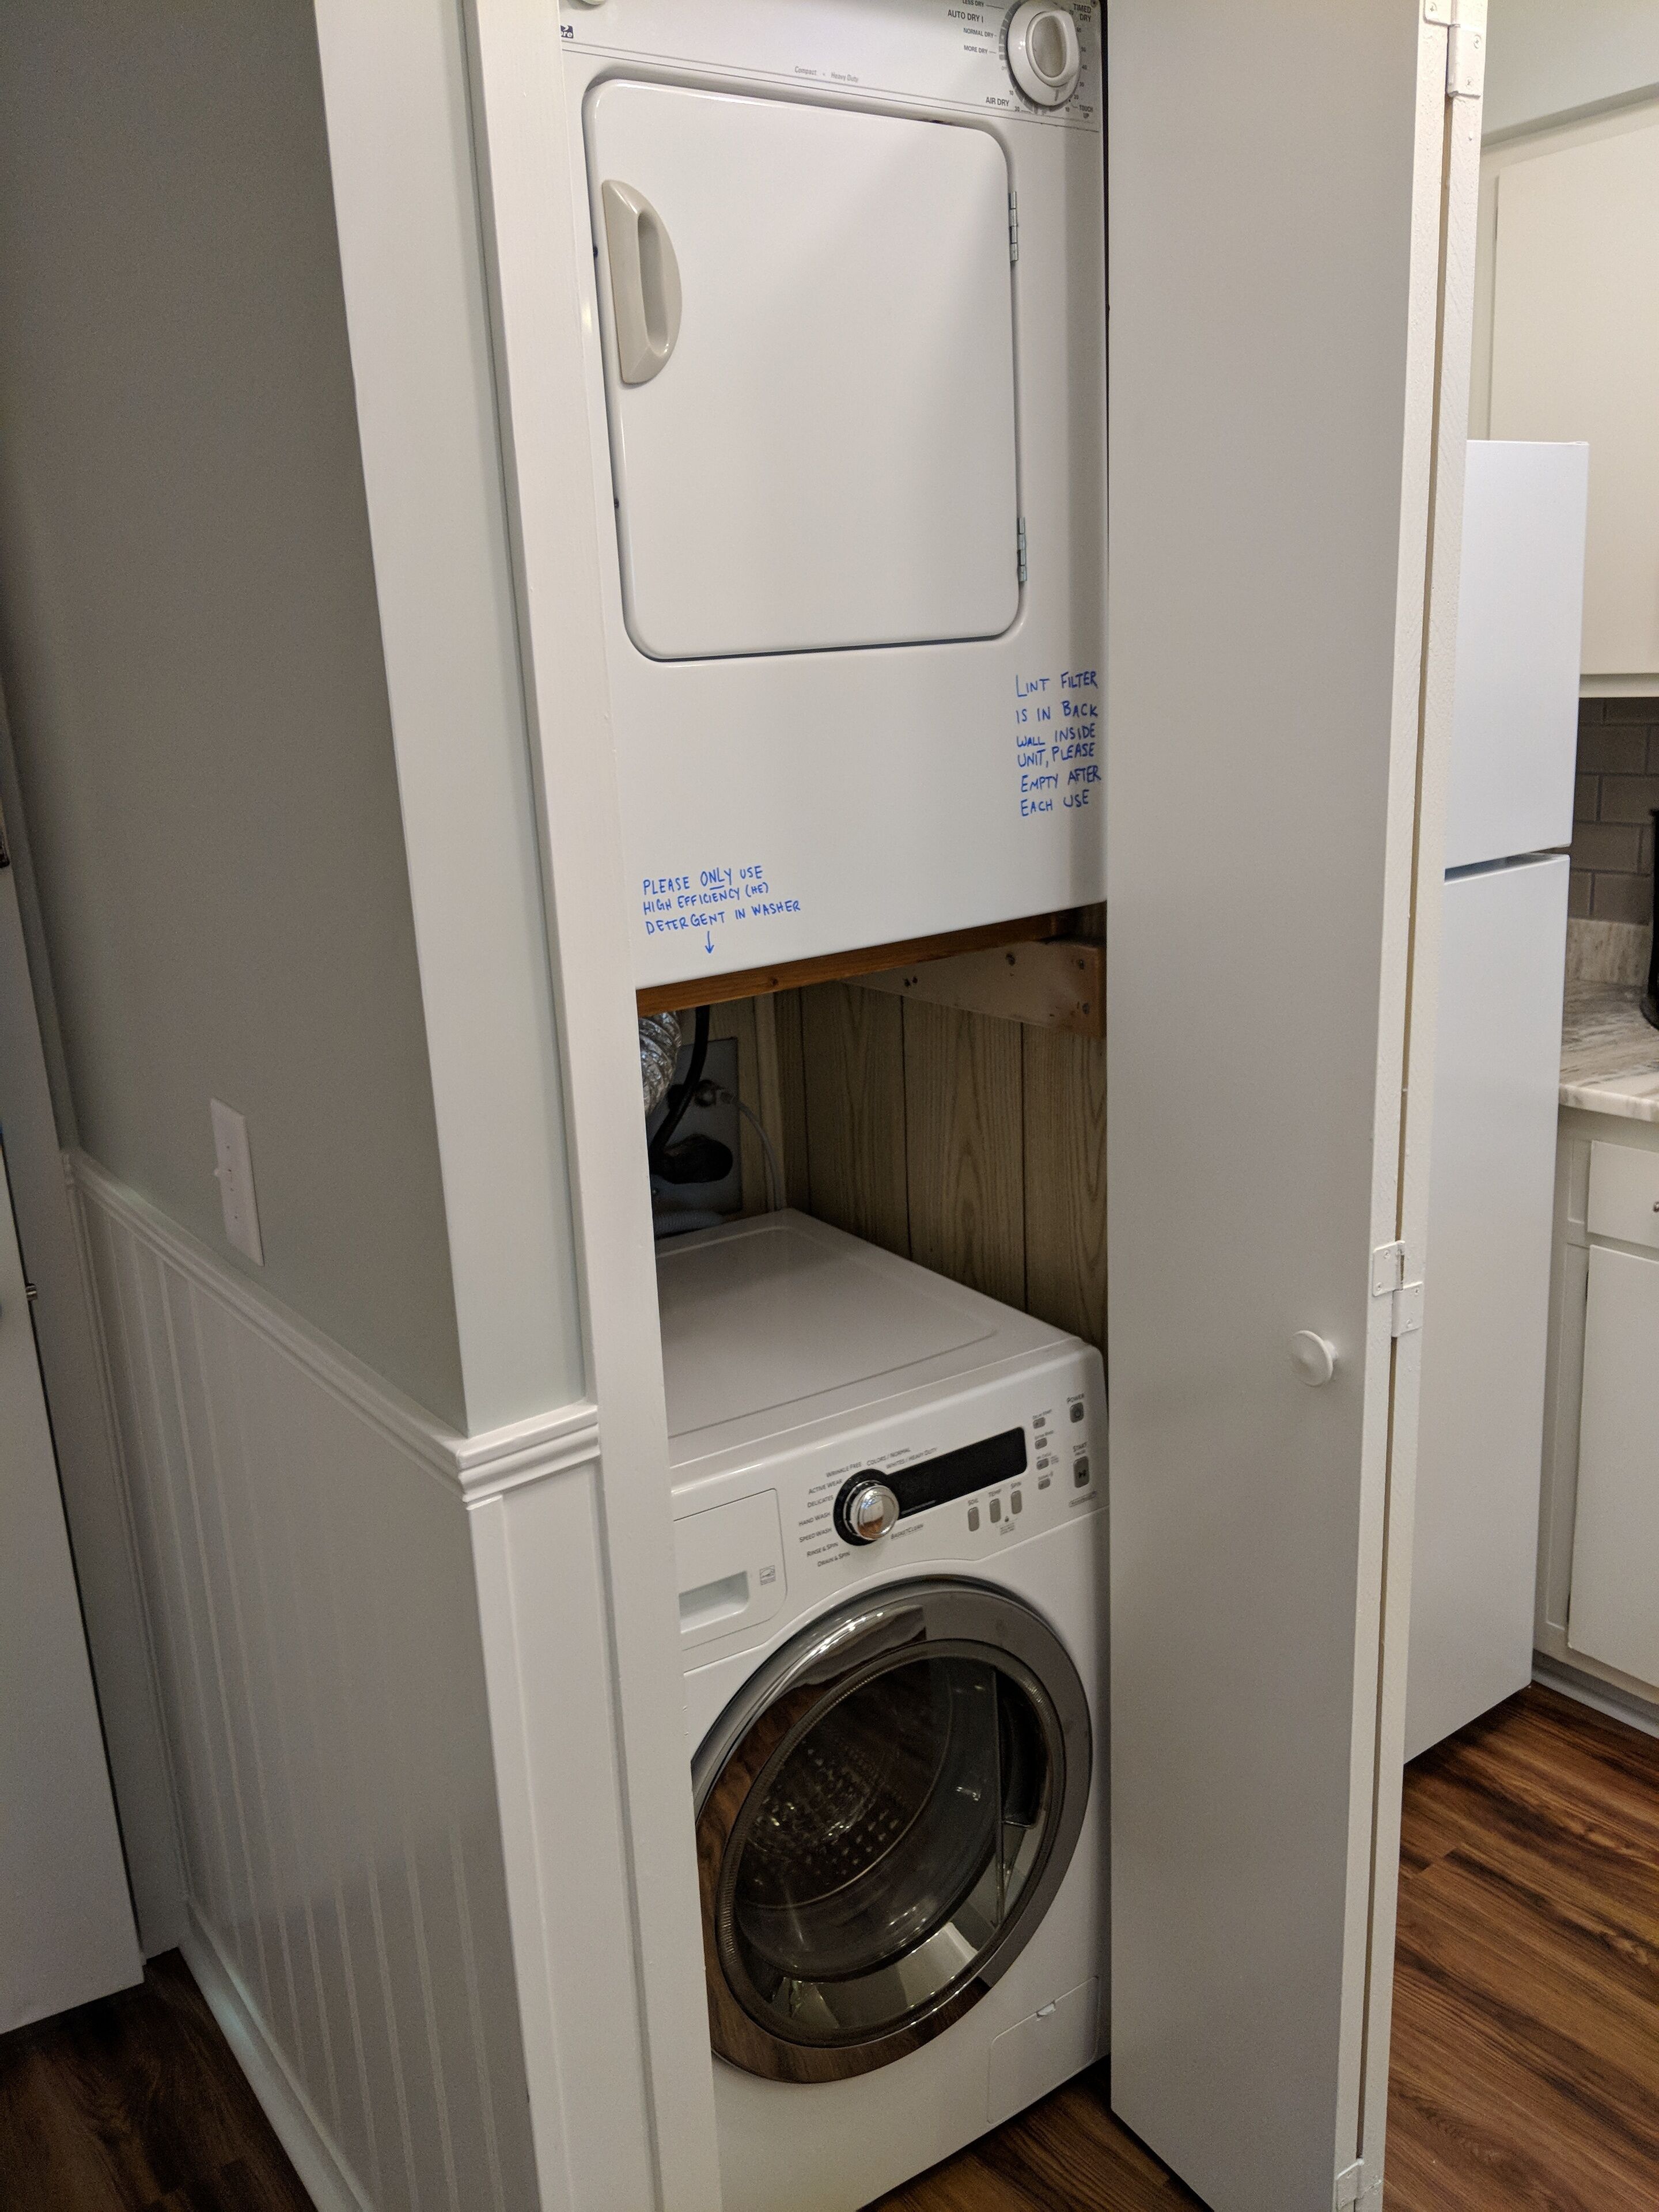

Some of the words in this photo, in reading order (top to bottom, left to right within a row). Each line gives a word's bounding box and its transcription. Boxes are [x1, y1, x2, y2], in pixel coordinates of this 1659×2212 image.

[948, 10, 965, 19] AUTO
[967, 13, 979, 22] DRY
[1073, 3, 1091, 13] TIMED
[963, 28, 983, 36] NORMAL
[795, 66, 816, 75] Compact
[986, 96, 996, 104] AIR
[1016, 675, 1050, 697] LINT
[1061, 672, 1098, 688] FILTER
[1016, 709, 1027, 724] IS
[1037, 707, 1051, 722] IN
[1062, 700, 1098, 717] BACK
[1016, 736, 1046, 747] WALL
[1055, 723, 1096, 743] INSIDE
[1017, 750, 1048, 767] UNIT,
[1051, 743, 1094, 762] PLEASE
[1021, 775, 1058, 793] EMPTY
[1067, 765, 1101, 785] AFTER
[1020, 799, 1053, 816] EACH
[1063, 790, 1089, 806] USE
[643, 876, 690, 895] PLEASE
[700, 868, 732, 886] ONLY
[740, 866, 763, 880] USE
[643, 899, 672, 915] HIGH
[677, 888, 740, 908] EFFICIENCY
[745, 882, 768, 897] (HE)
[645, 911, 725, 935] DETERGENT
[735, 909, 745, 920] IN
[751, 900, 800, 916] WASHER
[808, 1485, 825, 1494] ACTIVE
[807, 1495, 833, 1508] DELICATES
[798, 1517, 813, 1526] HAND
[814, 1512, 831, 1520] WASH
[799, 1533, 815, 1542] SPEED
